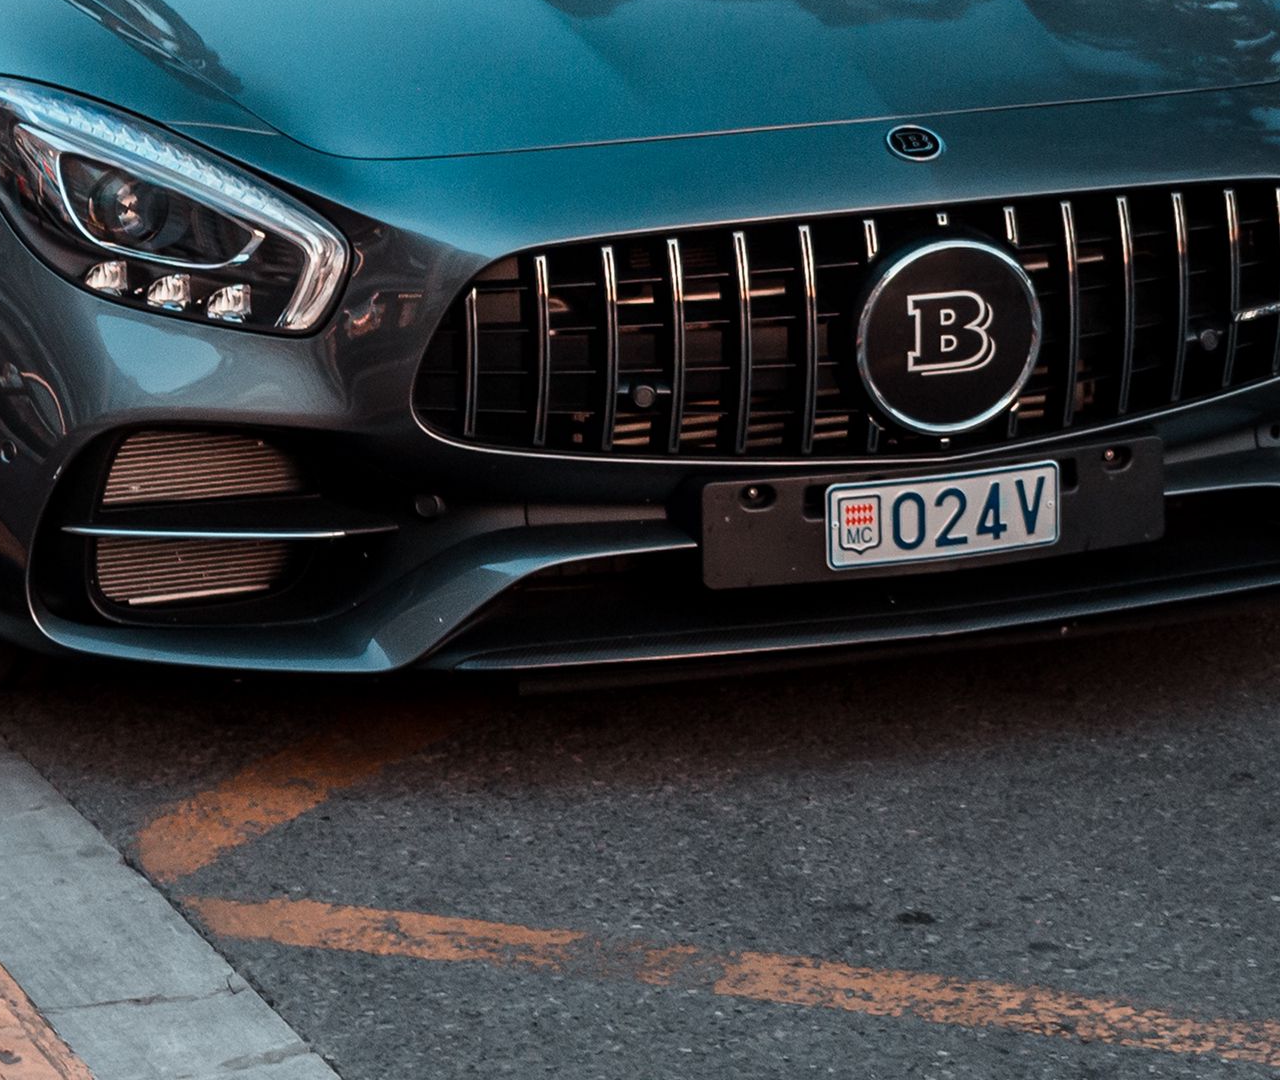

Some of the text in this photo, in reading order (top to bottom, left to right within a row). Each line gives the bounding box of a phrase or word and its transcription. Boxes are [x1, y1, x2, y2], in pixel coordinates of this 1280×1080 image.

[895, 132, 933, 151] B
[907, 290, 996, 376] B
[847, 526, 873, 544] MC
[892, 476, 1046, 550] 024V
